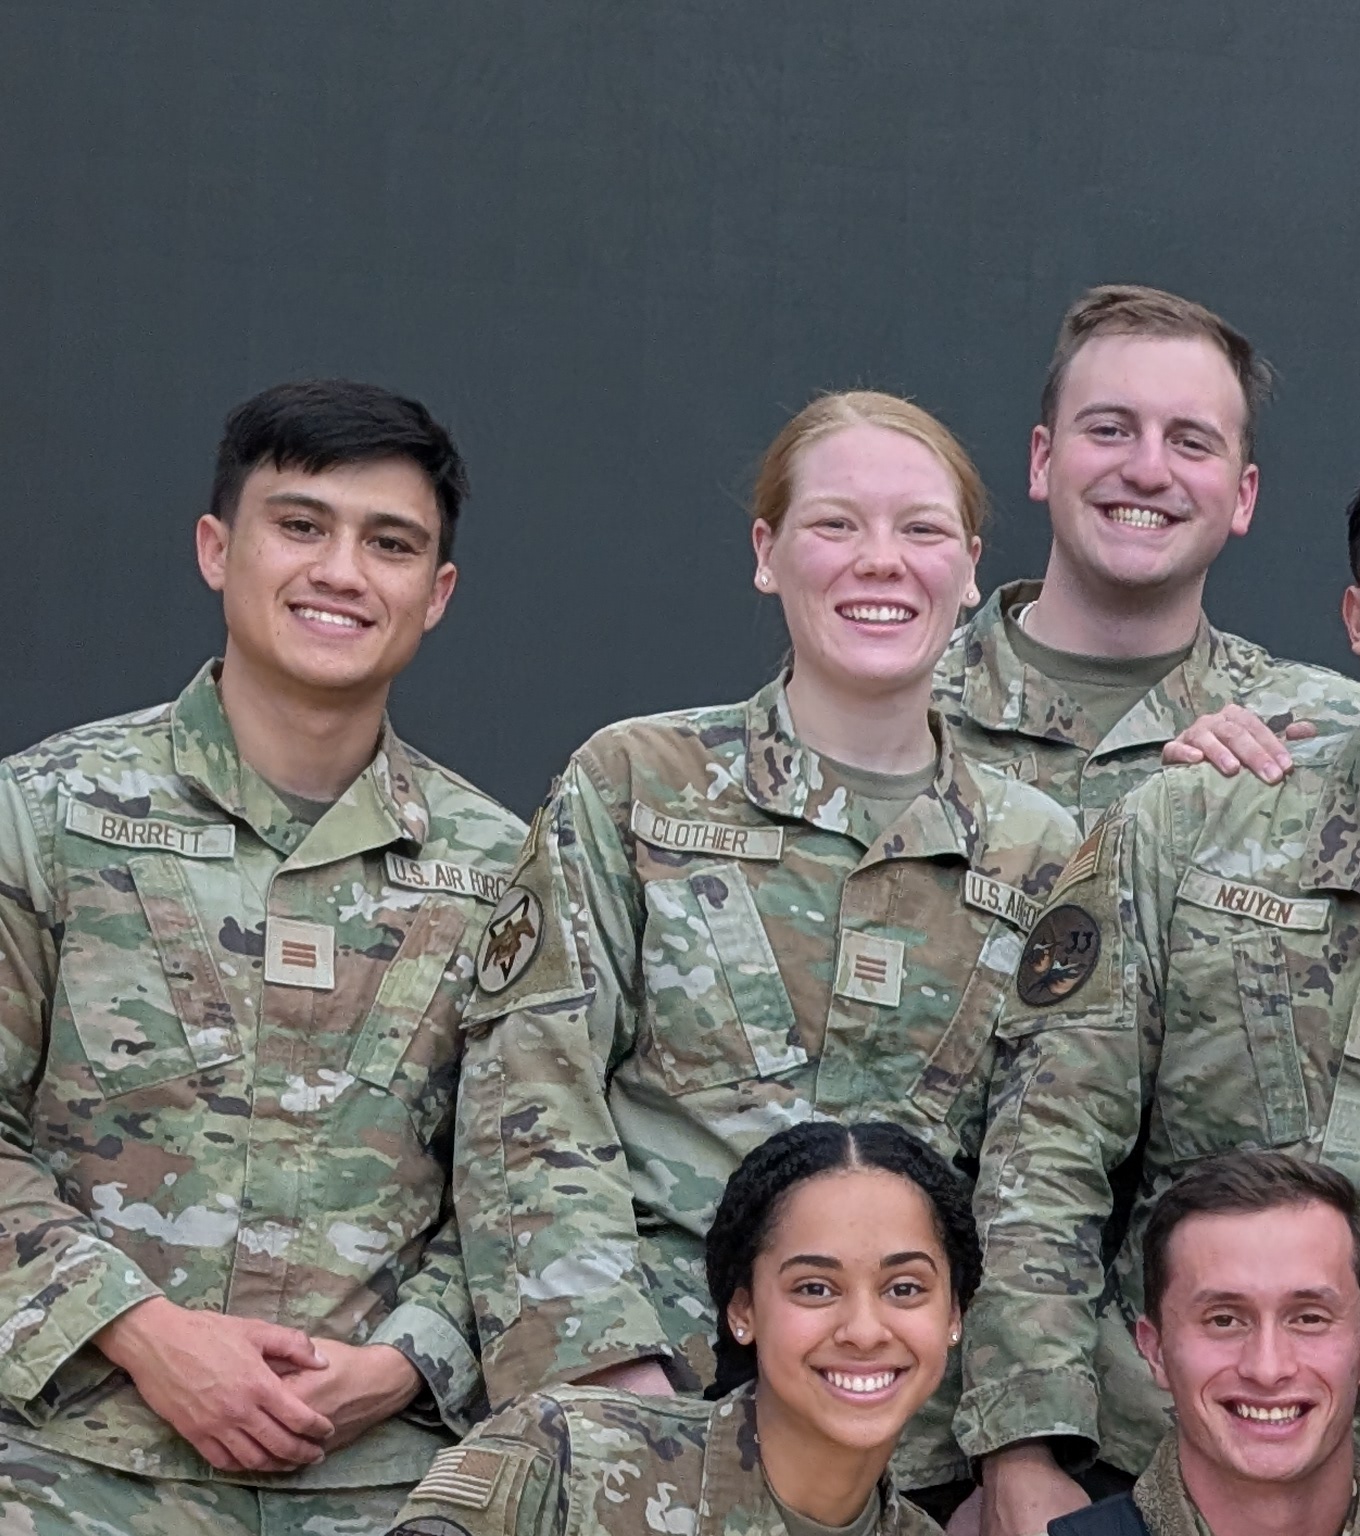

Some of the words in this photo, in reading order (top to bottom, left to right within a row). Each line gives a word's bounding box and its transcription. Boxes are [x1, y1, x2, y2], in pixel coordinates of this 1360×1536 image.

[101, 816, 203, 853] BARRETT
[652, 816, 749, 854] CLOTHIER
[392, 858, 430, 886] U.S.
[435, 864, 466, 891] AIR
[468, 867, 512, 899] FORC
[971, 876, 1003, 912] U.S.
[1214, 884, 1294, 924] NGUYEN
